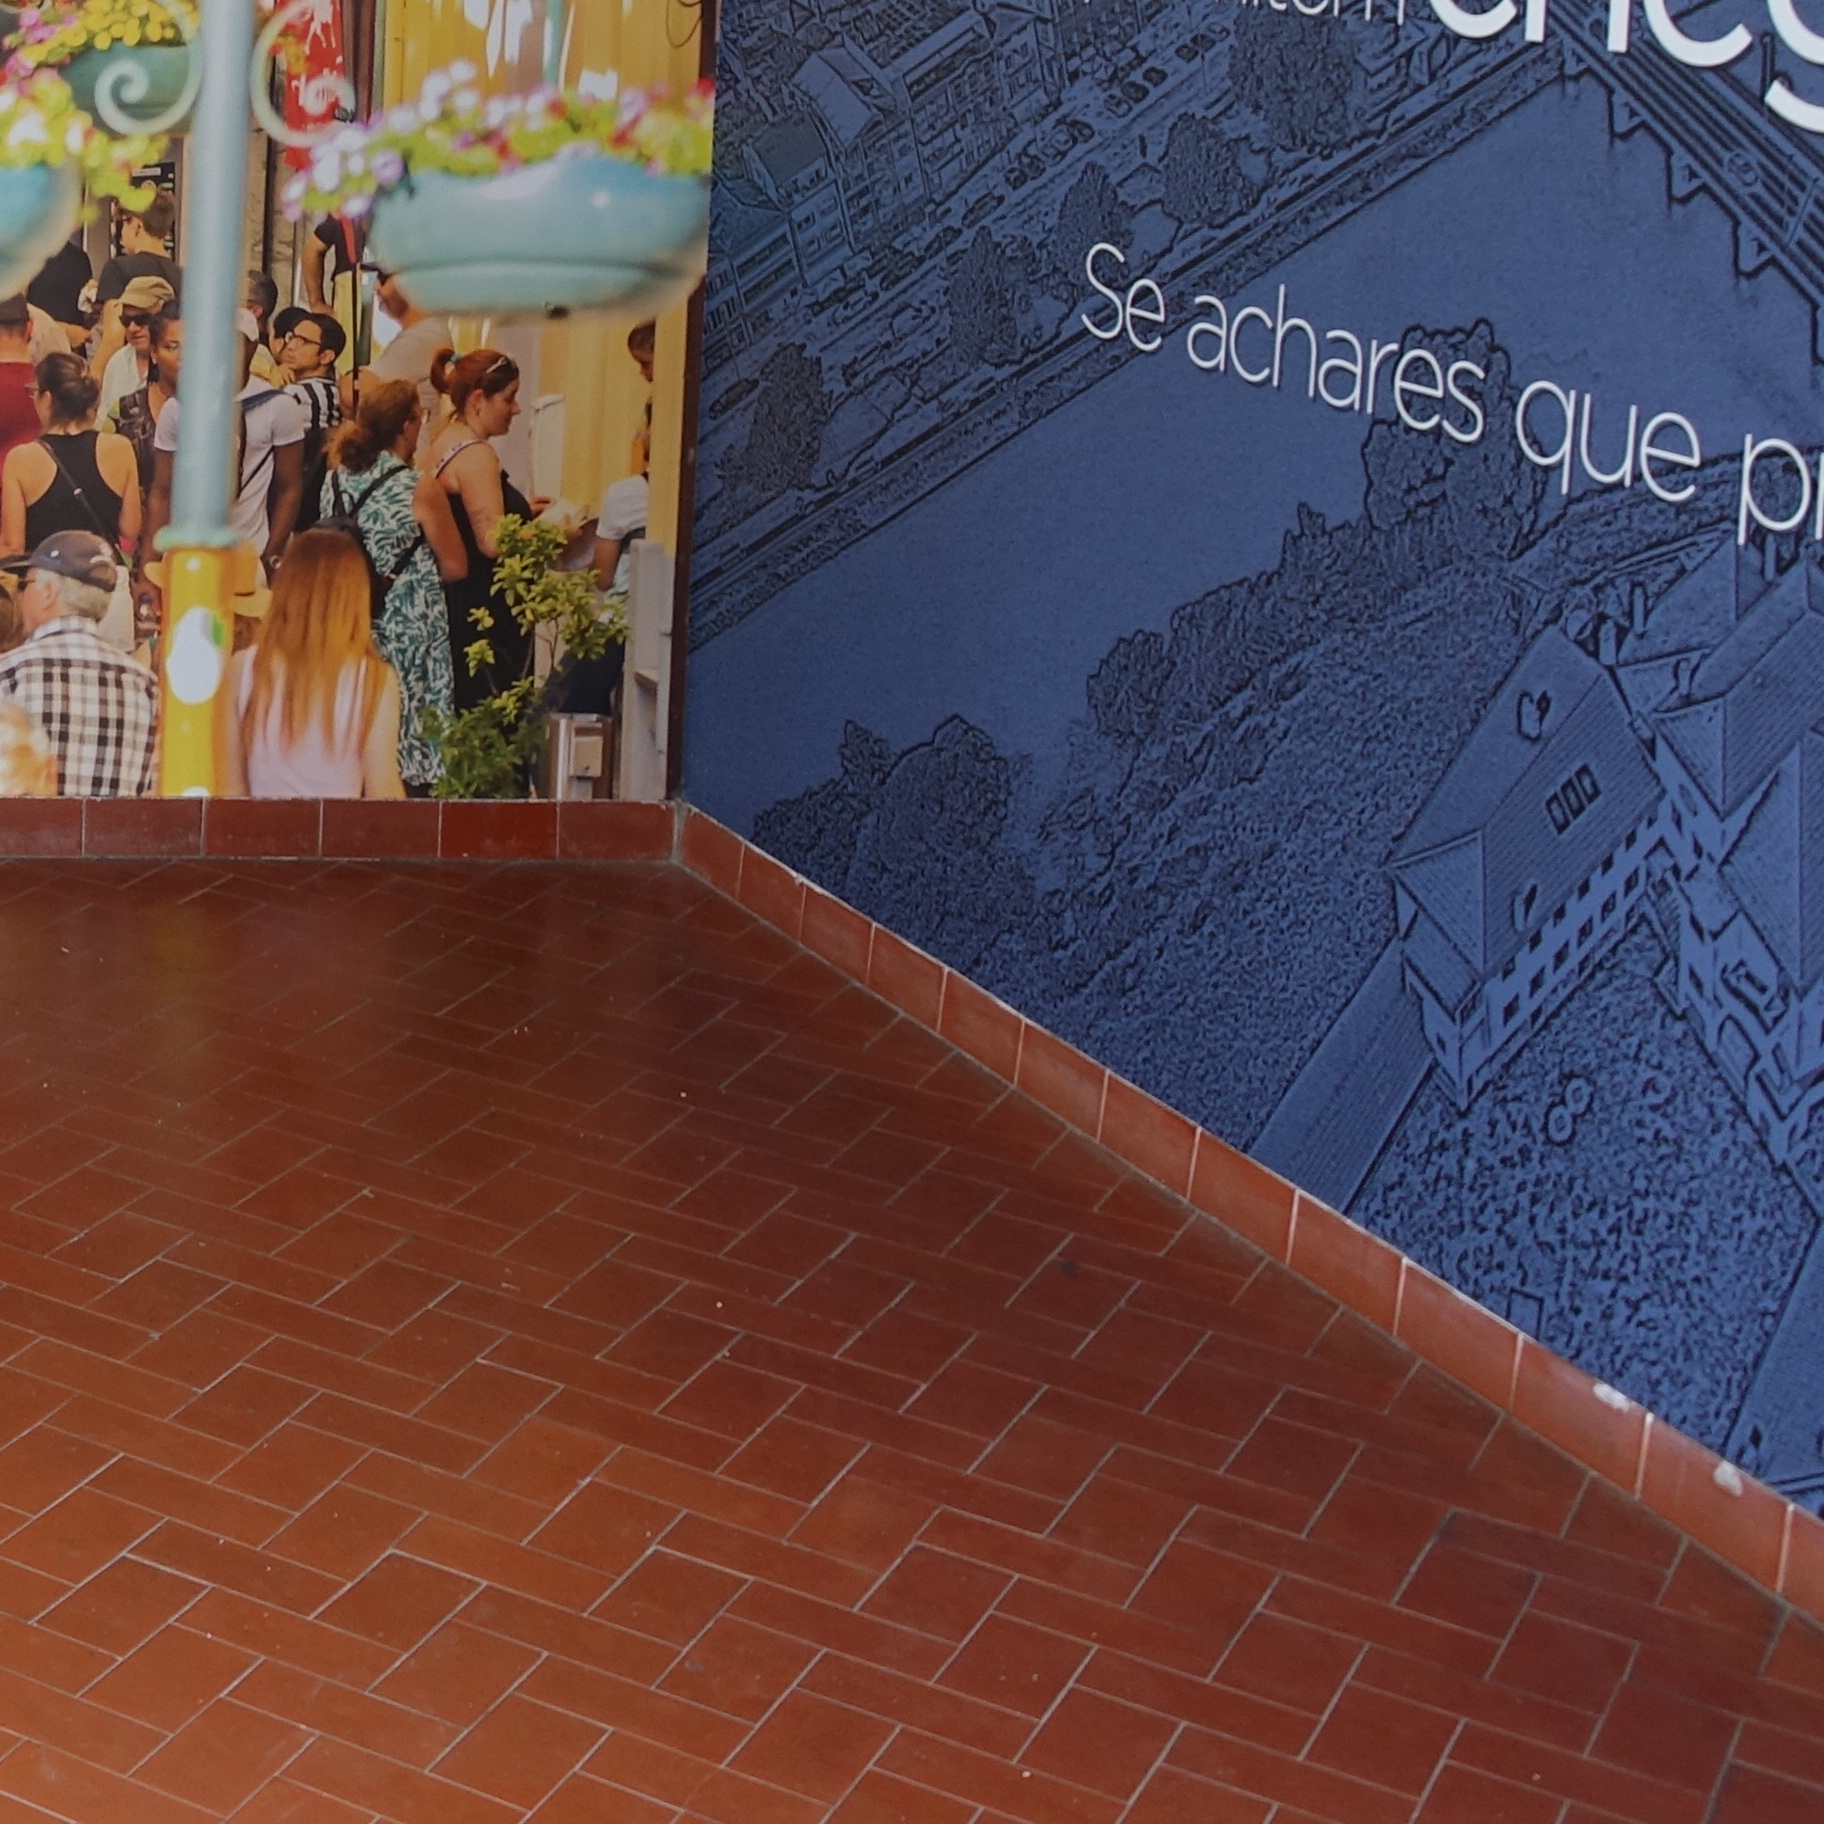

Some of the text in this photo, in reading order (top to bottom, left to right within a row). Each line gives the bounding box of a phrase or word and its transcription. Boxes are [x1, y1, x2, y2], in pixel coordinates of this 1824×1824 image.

[1079, 240, 1167, 353] Se
[1186, 285, 1486, 445] achares
[1514, 376, 1701, 504] que
